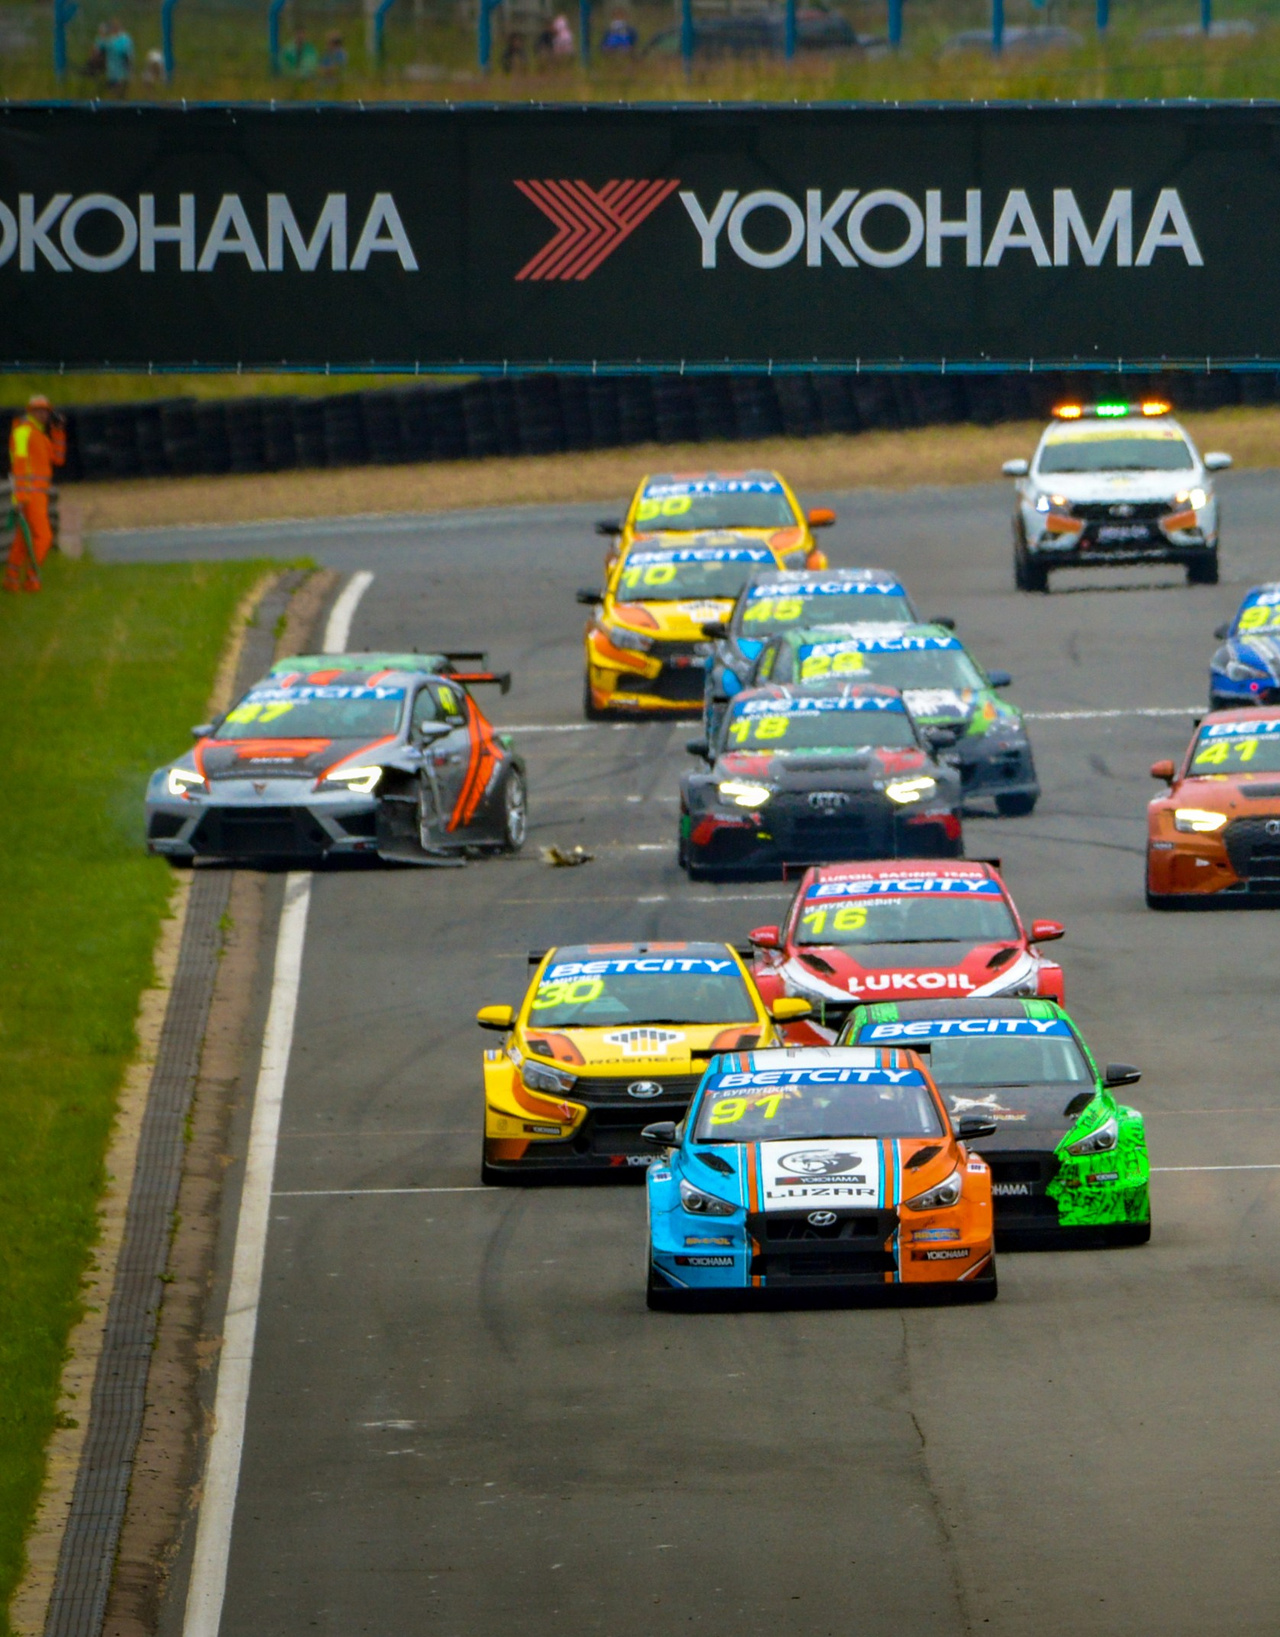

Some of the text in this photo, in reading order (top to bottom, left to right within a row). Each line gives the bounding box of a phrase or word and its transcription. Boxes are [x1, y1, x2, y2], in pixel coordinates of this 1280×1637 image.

[0, 193, 418, 273] KOHAMA
[679, 188, 1204, 269] YOKOHAMA
[622, 563, 676, 588] 10
[754, 582, 896, 597] BETCITY
[811, 638, 952, 656] BETCITY
[743, 697, 894, 713] BETCITY
[729, 716, 789, 743] 18
[1195, 740, 1258, 764] 41
[816, 878, 989, 896] BETCITY
[803, 907, 868, 934] 16
[550, 958, 732, 978] BETCITY
[848, 973, 976, 992] LUKOIL
[532, 980, 604, 1010] 30
[870, 1018, 1058, 1038] BETCITY
[719, 1069, 912, 1088] BETCITY
[709, 1093, 784, 1126] 91
[801, 1176, 859, 1184] YOKOHAMA
[766, 1188, 875, 1199] LUZAR
[688, 1257, 733, 1266] YOKOHAMA
[927, 1248, 968, 1260] YOKOHAMA
